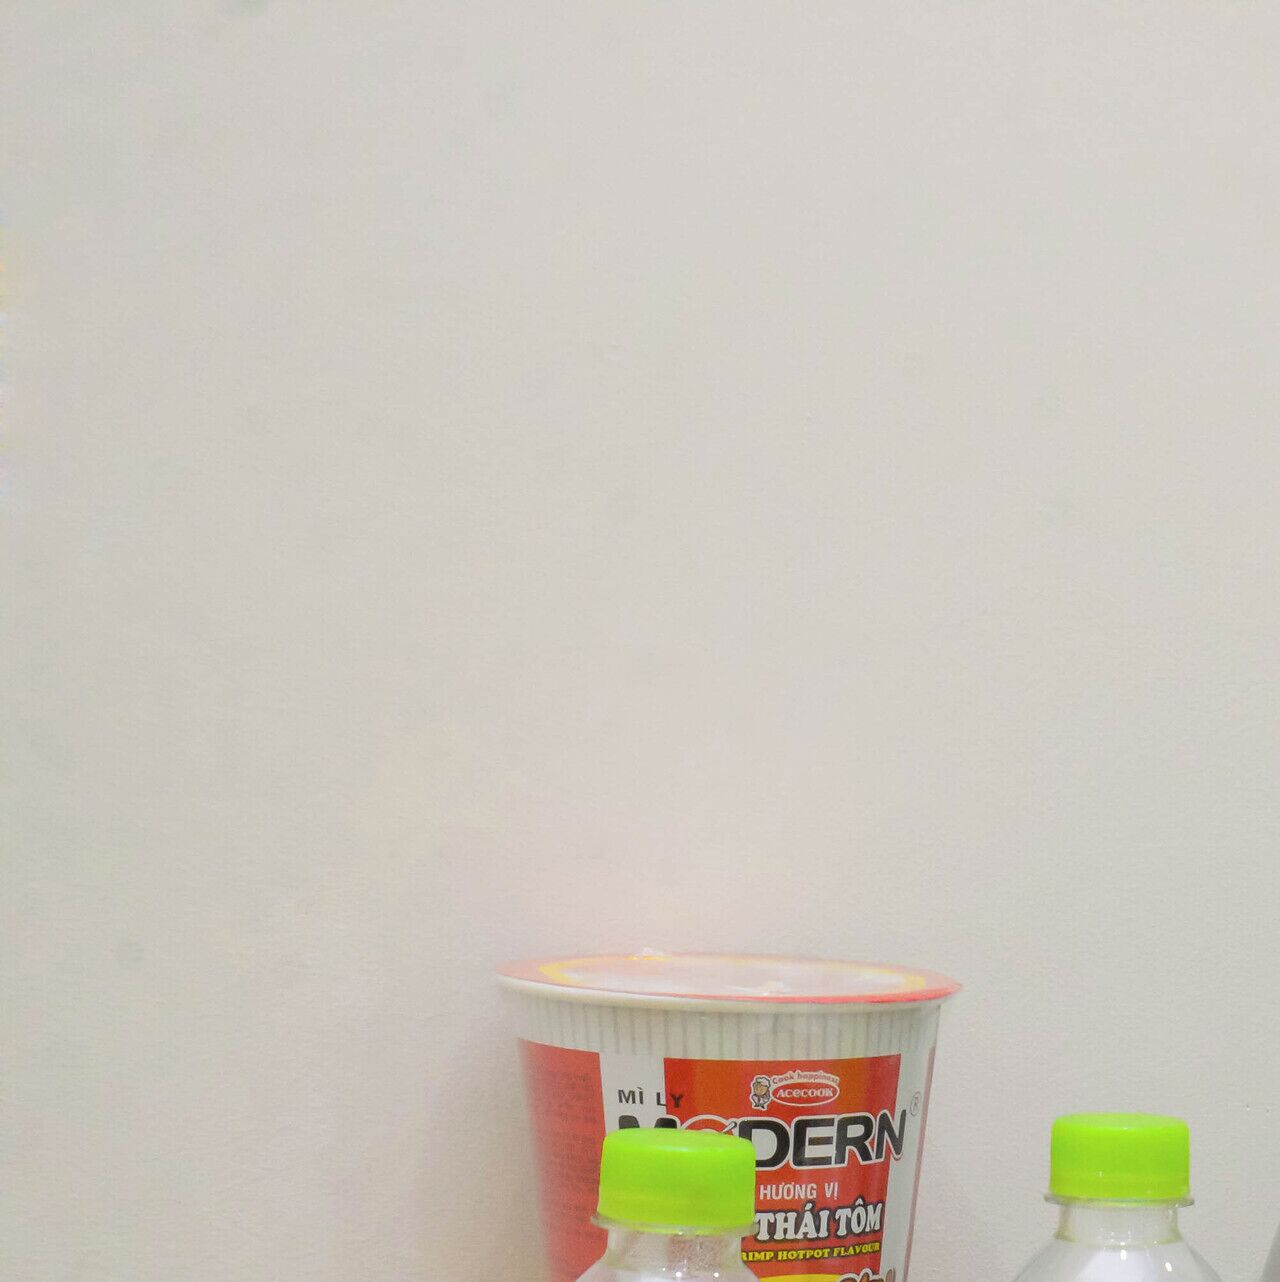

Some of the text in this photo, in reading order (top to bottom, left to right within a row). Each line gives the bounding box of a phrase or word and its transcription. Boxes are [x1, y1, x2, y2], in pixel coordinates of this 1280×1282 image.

[617, 1086, 644, 1105] MÌ
[759, 1182, 838, 1200] HƯƠNG VỊ
[756, 1198, 882, 1241] THÁI TÔM
[777, 1247, 830, 1261] HOTPOT
[833, 1242, 880, 1258] FLAVOUR
